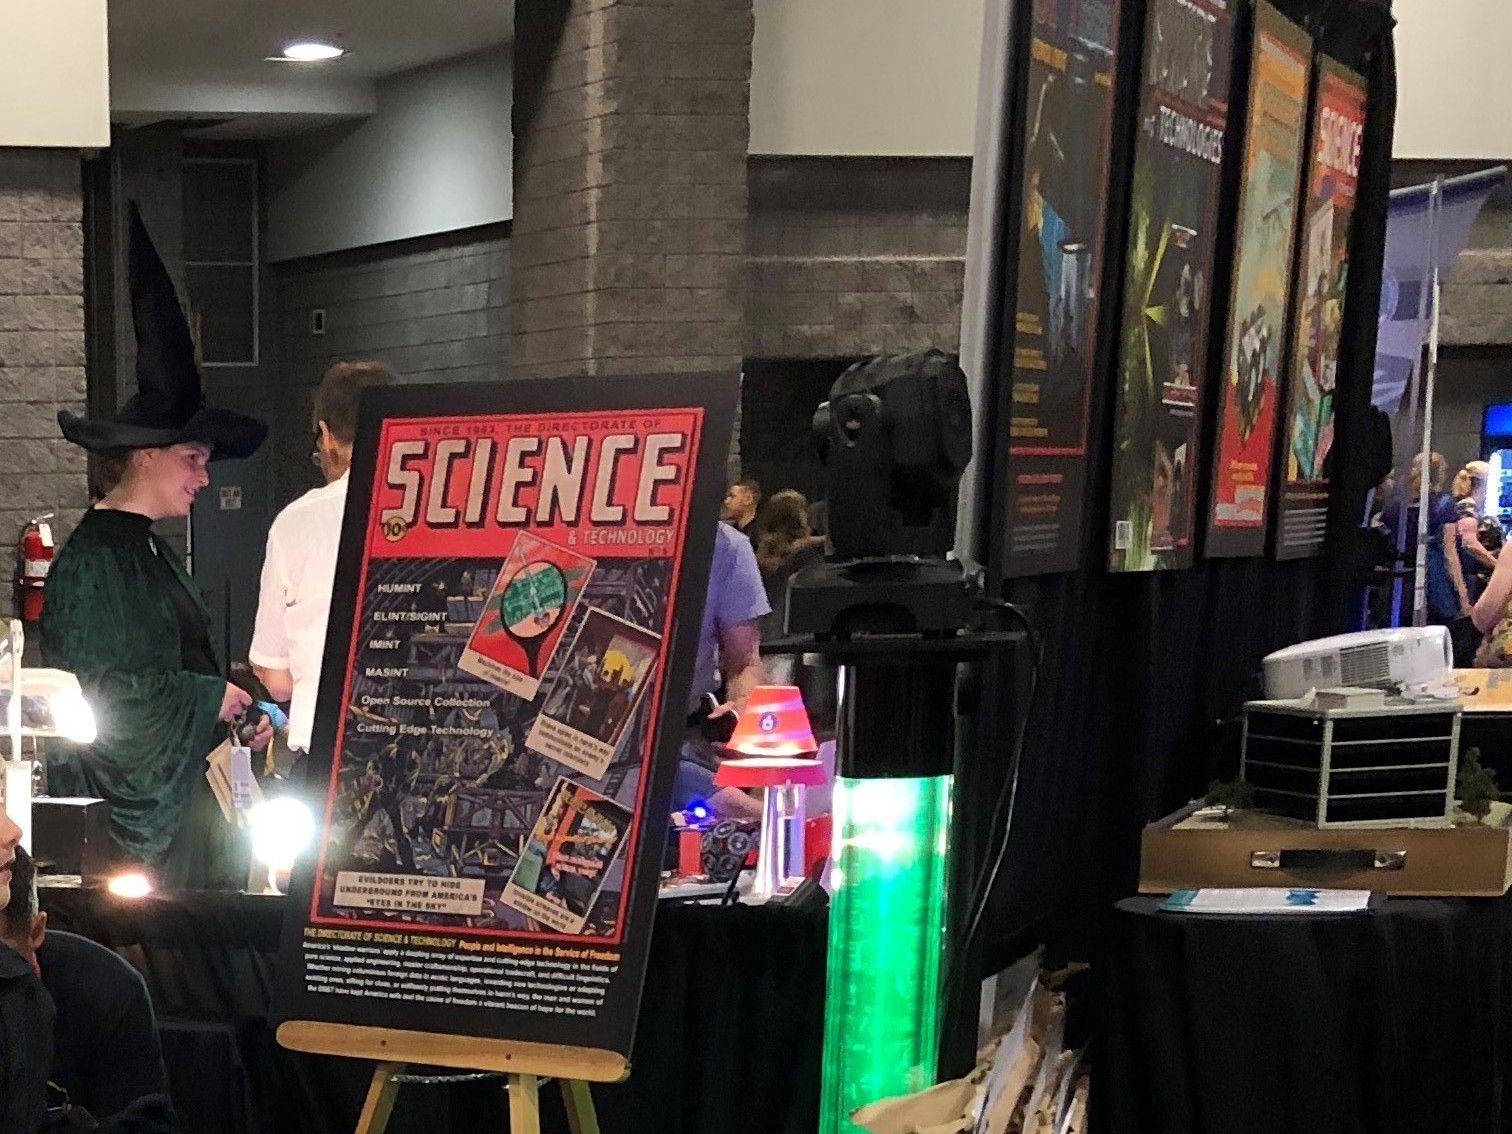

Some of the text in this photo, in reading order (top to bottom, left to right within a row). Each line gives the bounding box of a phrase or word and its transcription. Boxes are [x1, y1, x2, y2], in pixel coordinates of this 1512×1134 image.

[420, 426, 459, 436] SINCE
[506, 423, 531, 434] THE
[539, 420, 636, 434] DIRECTORATE
[643, 419, 661, 429] OF
[381, 432, 687, 526] SCIENCE
[568, 529, 674, 545] & TECHNOLOGY
[377, 583, 422, 593] HUMINT
[374, 611, 447, 622] ELINT/SIGINT
[369, 639, 401, 650] IMINT
[365, 667, 409, 677] MASINT
[361, 696, 490, 707] Open Source Collection
[357, 724, 494, 737] Cutting Edge Technology
[358, 876, 461, 889] EVILDOERS TRY TO HIDE
[340, 886, 478, 901] UNDERGROUND FROM AMERICA'S
[395, 900, 403, 908] IN
[407, 901, 422, 909] THE
